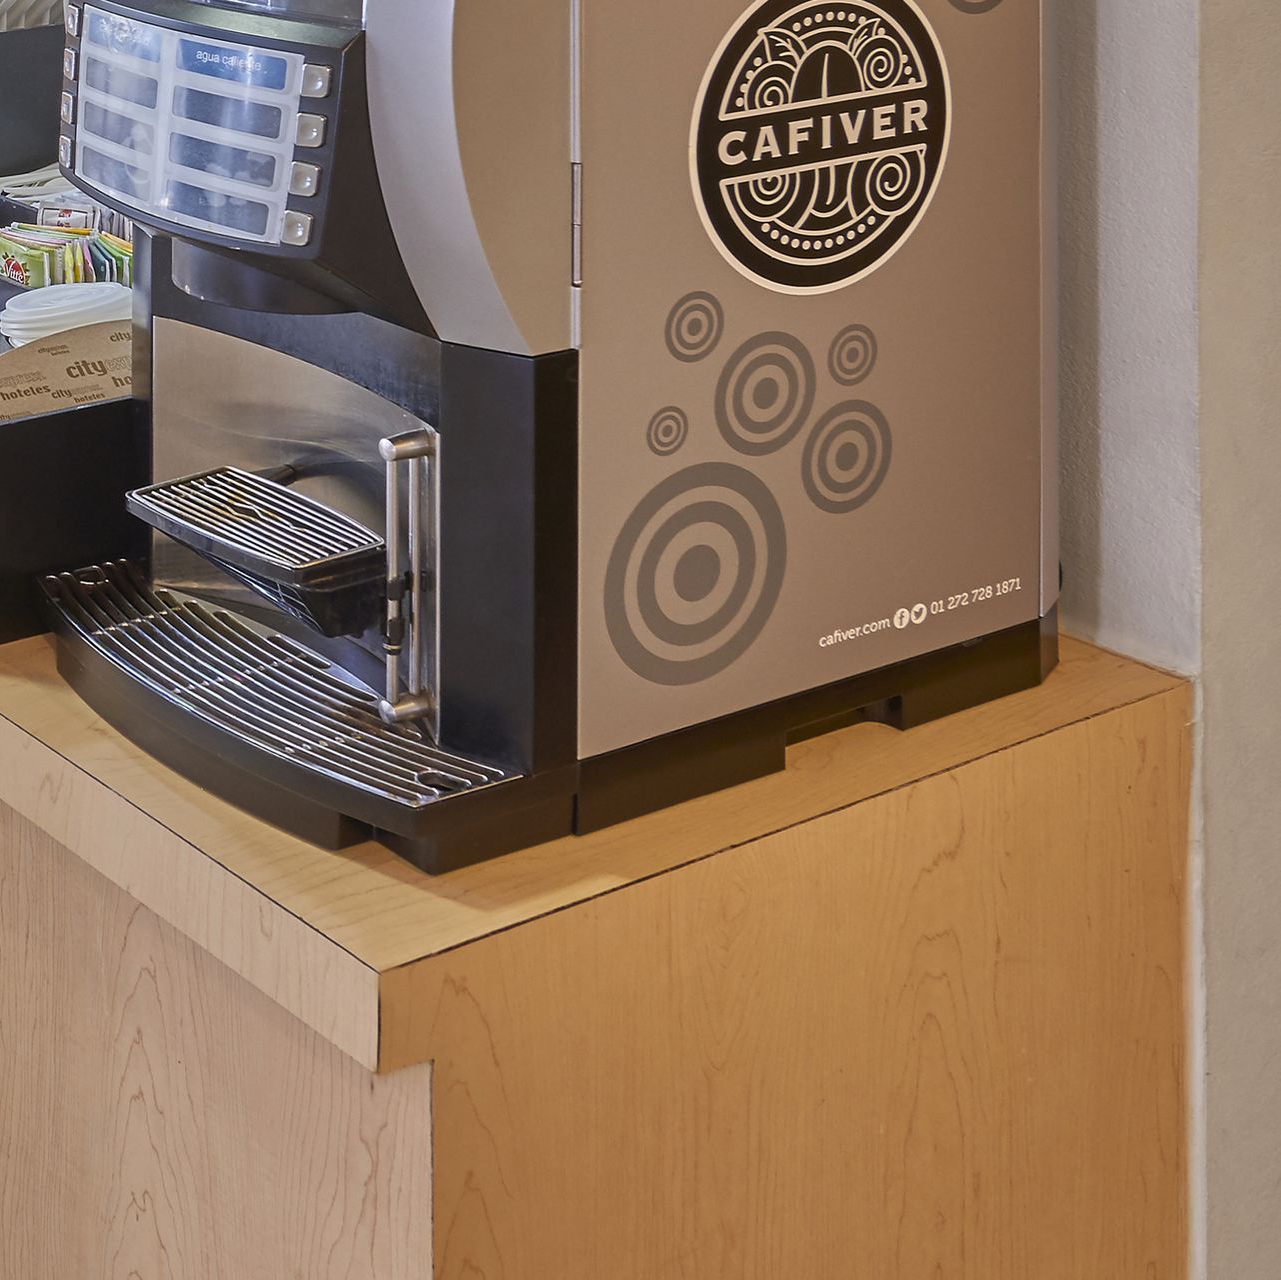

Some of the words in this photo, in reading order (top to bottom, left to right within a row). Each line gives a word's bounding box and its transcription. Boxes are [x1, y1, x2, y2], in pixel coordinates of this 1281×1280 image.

[195, 49, 220, 64] agua
[718, 98, 929, 167] CAFIVER
[0, 383, 52, 402] hoteles
[73, 392, 107, 404] hoteles
[818, 616, 891, 648] cafiver.com
[930, 599, 945, 615] 01
[947, 592, 970, 610] 272
[971, 585, 993, 603] 728
[995, 577, 1022, 596] 1871
